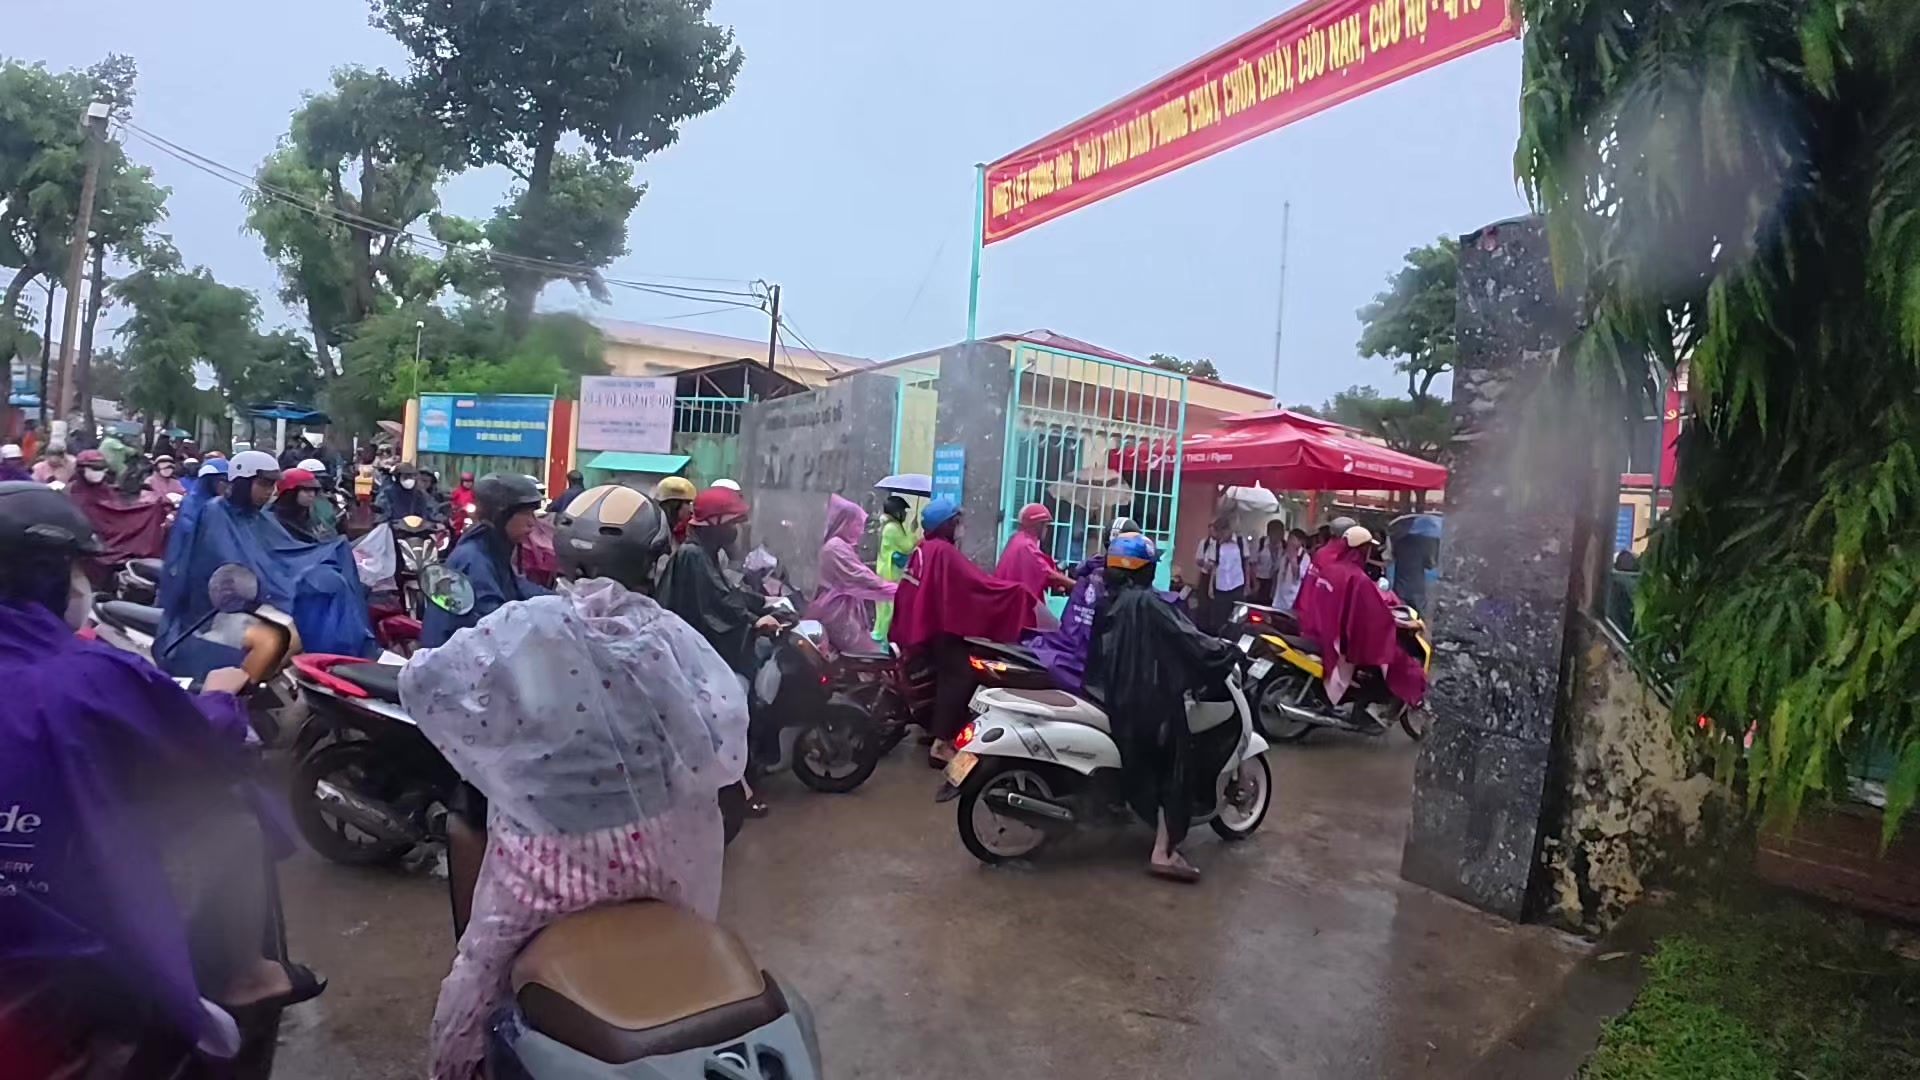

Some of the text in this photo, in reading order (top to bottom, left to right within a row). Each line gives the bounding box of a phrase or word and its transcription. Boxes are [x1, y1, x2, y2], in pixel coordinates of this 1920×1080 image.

[1189, 72, 1222, 132] CHÁY,
[1223, 57, 1257, 118] CHỮA
[1258, 39, 1294, 102] CHÁY,
[1298, 23, 1325, 84] CỨU
[1328, 12, 1365, 77] NẠN,
